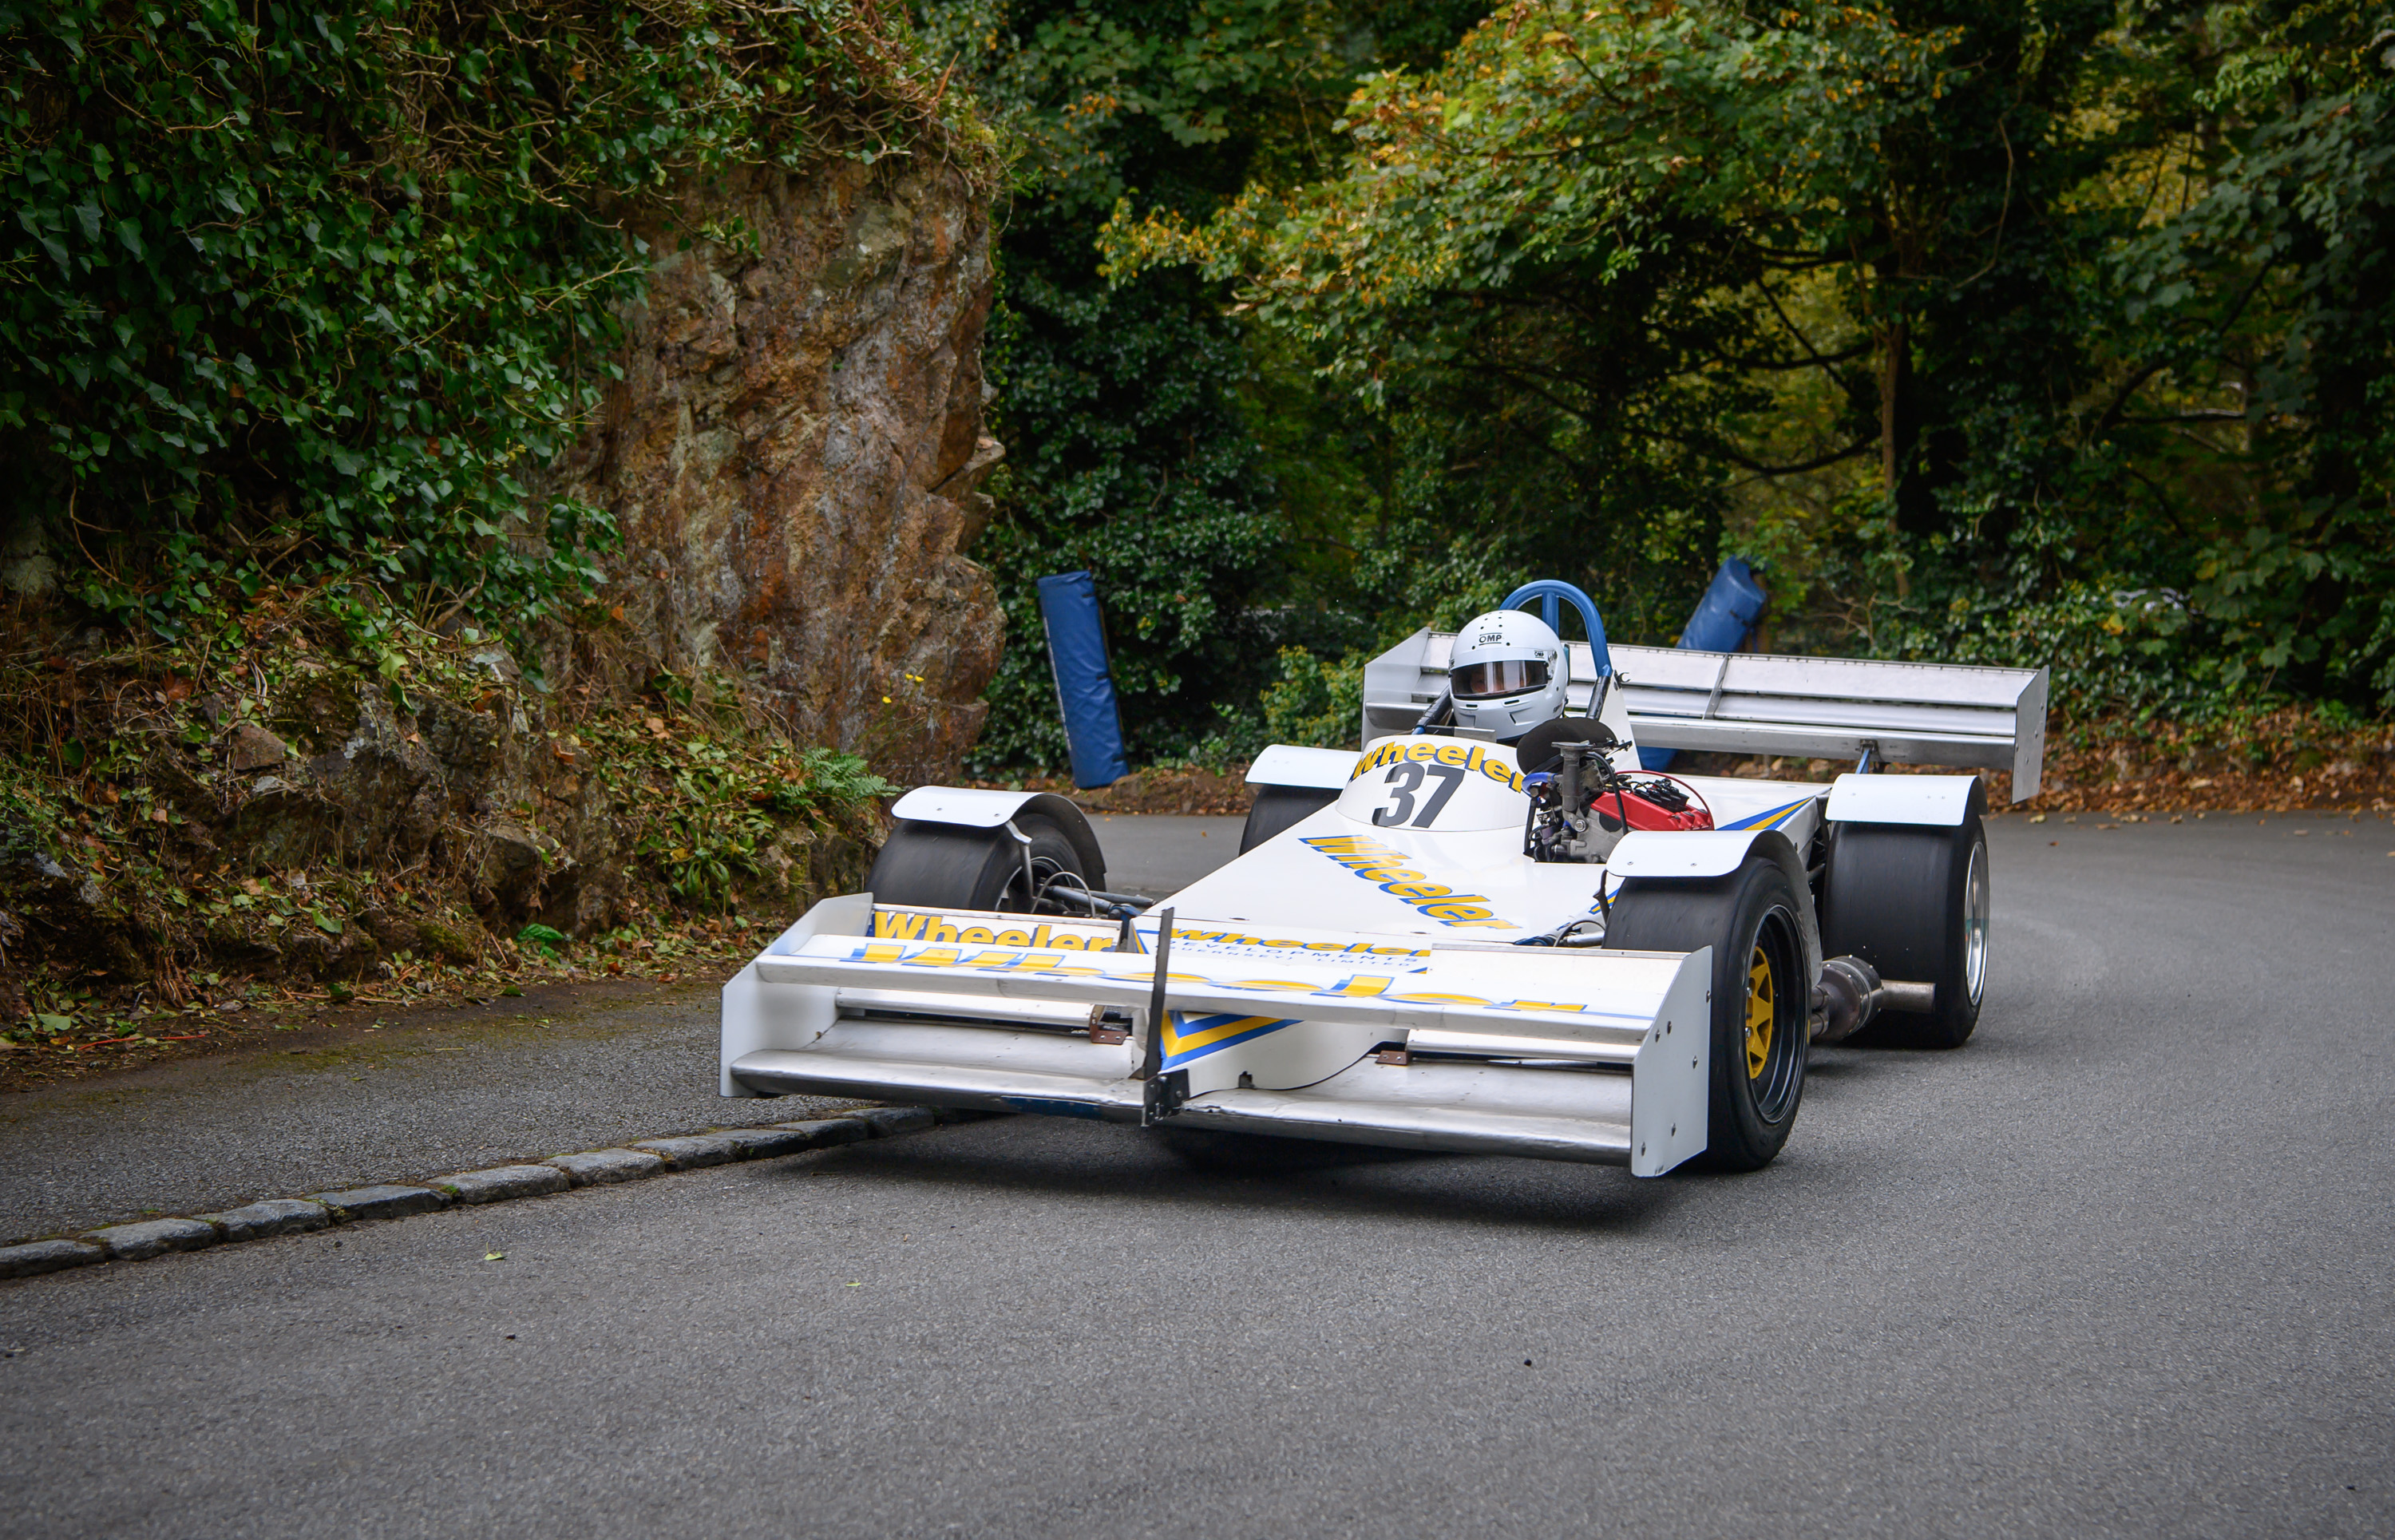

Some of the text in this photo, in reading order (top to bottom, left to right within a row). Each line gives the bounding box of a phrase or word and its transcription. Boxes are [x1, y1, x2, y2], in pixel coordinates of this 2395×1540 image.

[1479, 633, 1502, 644] OMP
[1372, 762, 1466, 829] 37
[1297, 834, 1522, 929] Wheeler
[872, 911, 1115, 952] Wheeler
